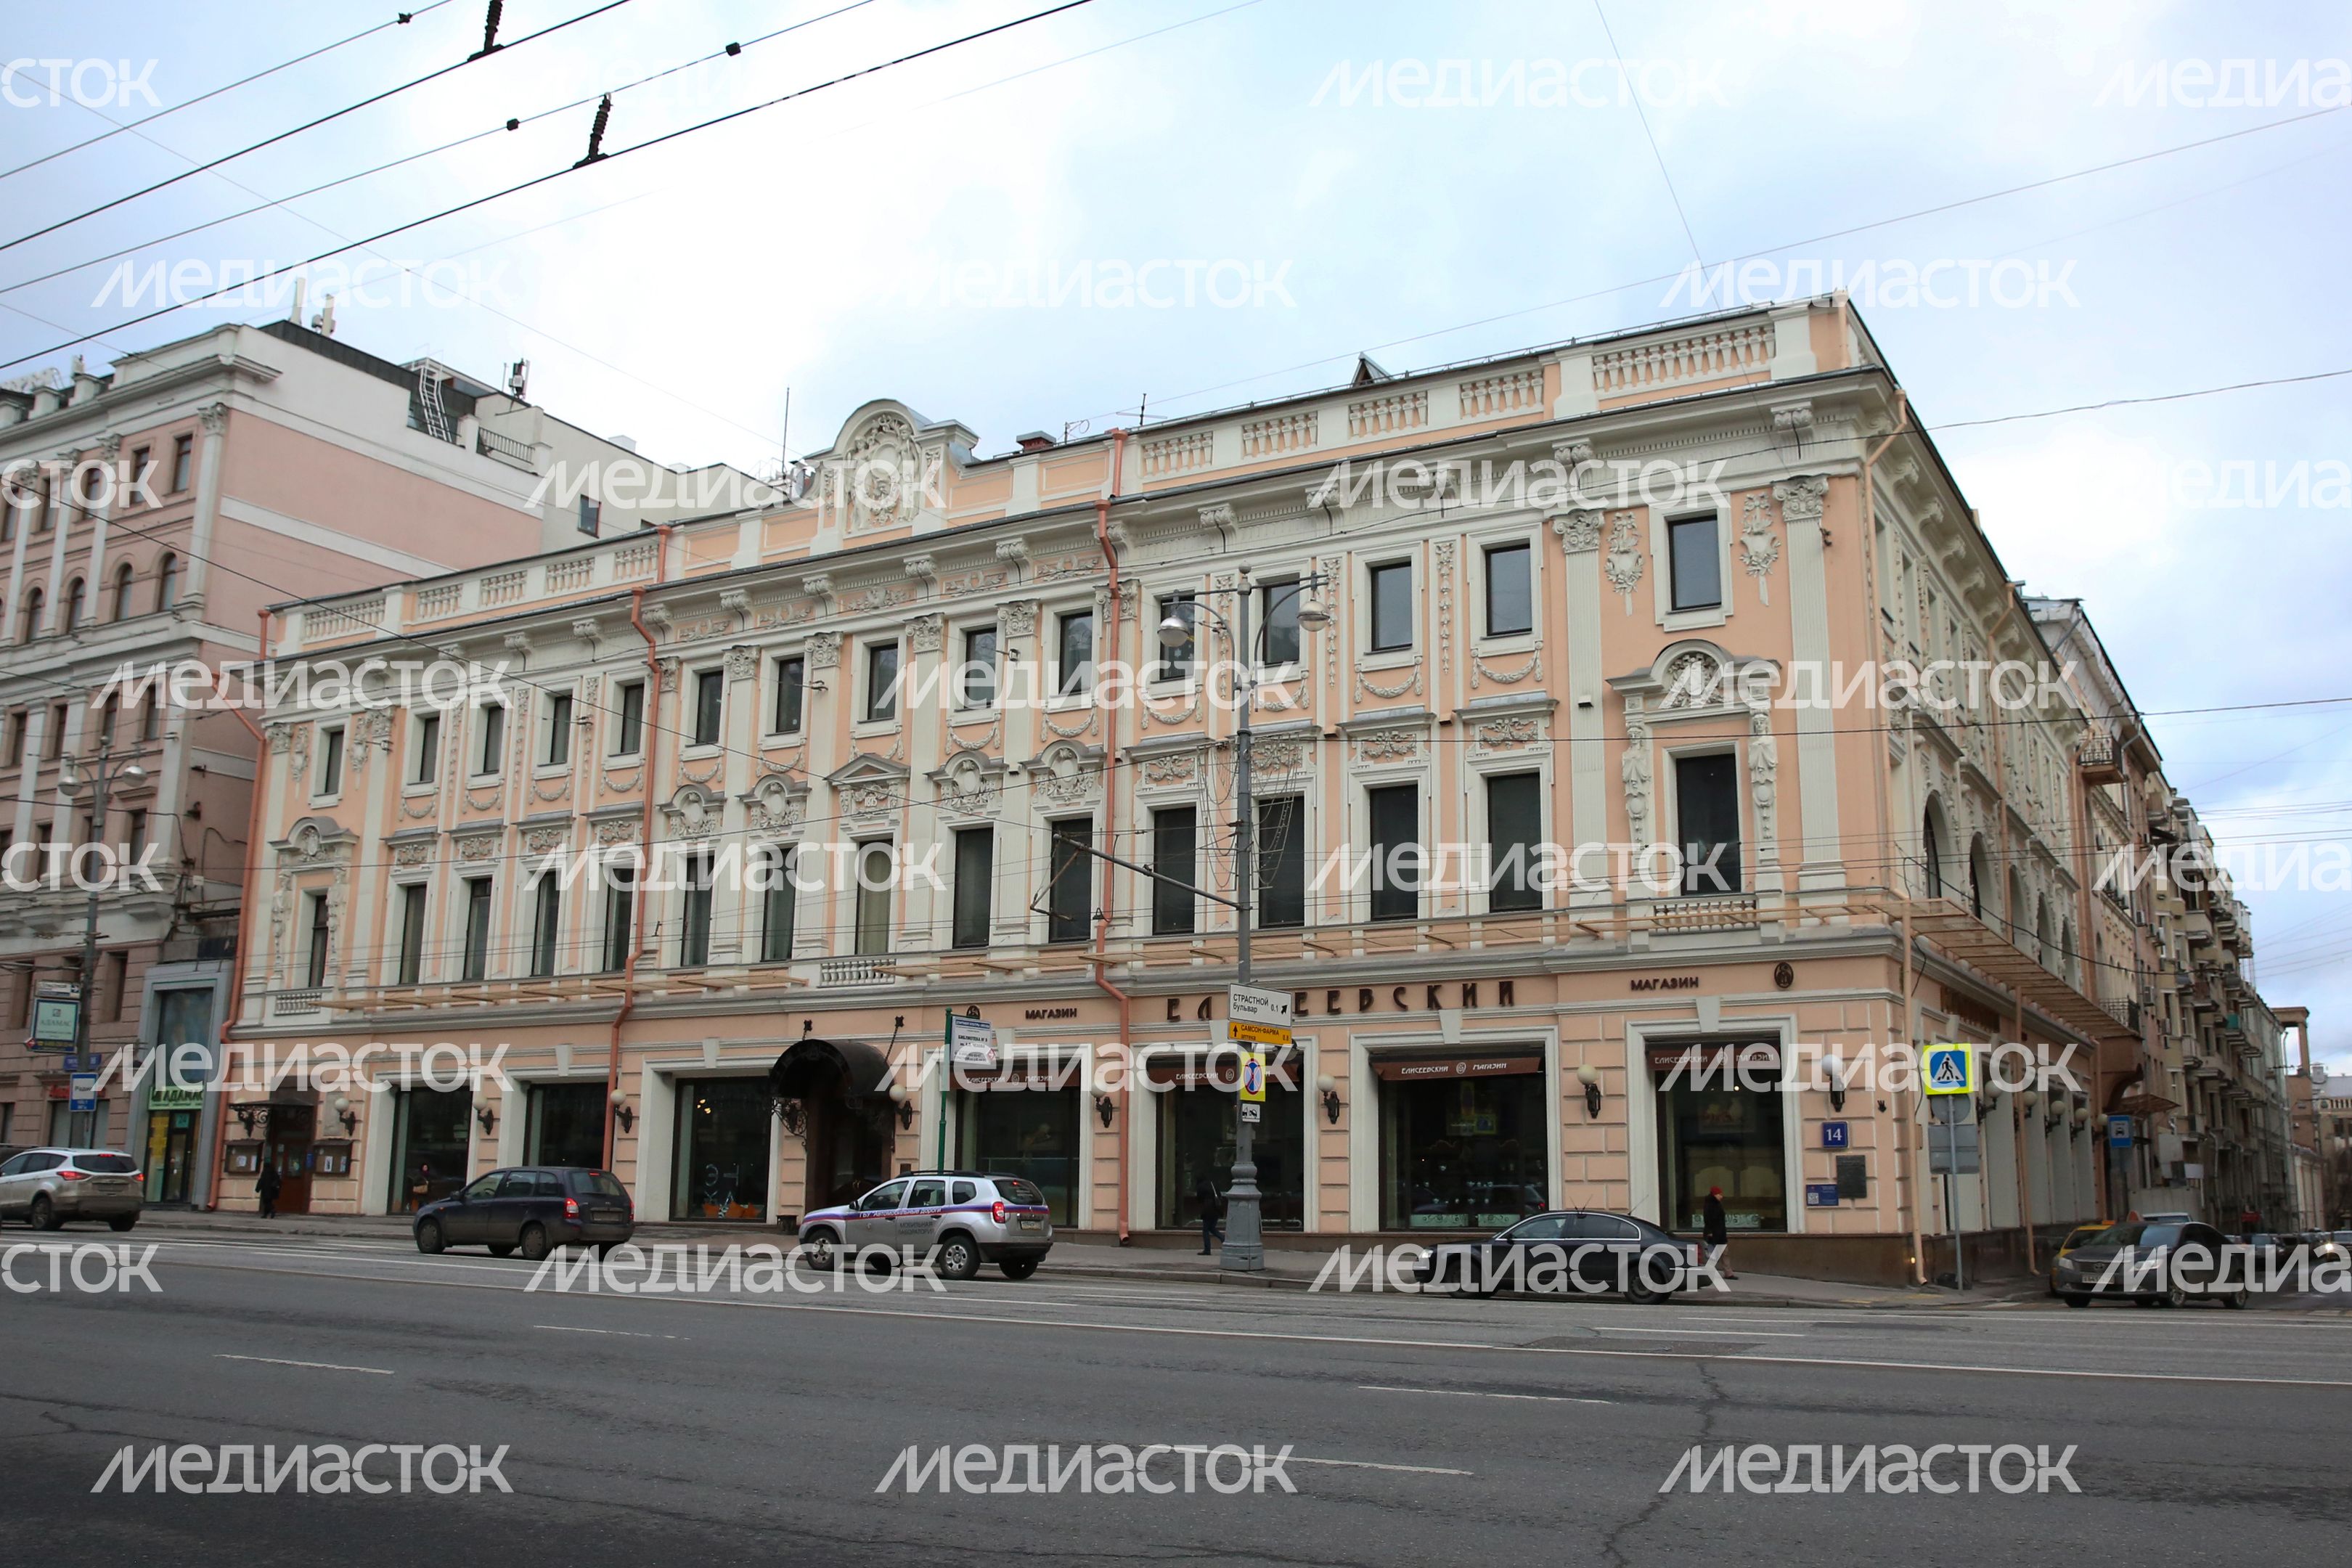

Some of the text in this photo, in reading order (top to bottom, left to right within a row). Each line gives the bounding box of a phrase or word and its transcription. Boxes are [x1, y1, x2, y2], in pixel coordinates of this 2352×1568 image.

[1630, 976, 1699, 990] МАГАЗИН
[1167, 981, 1514, 1022] ЕЛЕЕВСКИЙ
[1233, 994, 1269, 1006] СТРАСТНОЙ
[1025, 1008, 1077, 1019] МАГАЗИН
[1233, 1002, 1257, 1014] бульвар
[1241, 1024, 1280, 1035] САМСОН-ФАРМА
[1826, 1128, 1842, 1141] 14
